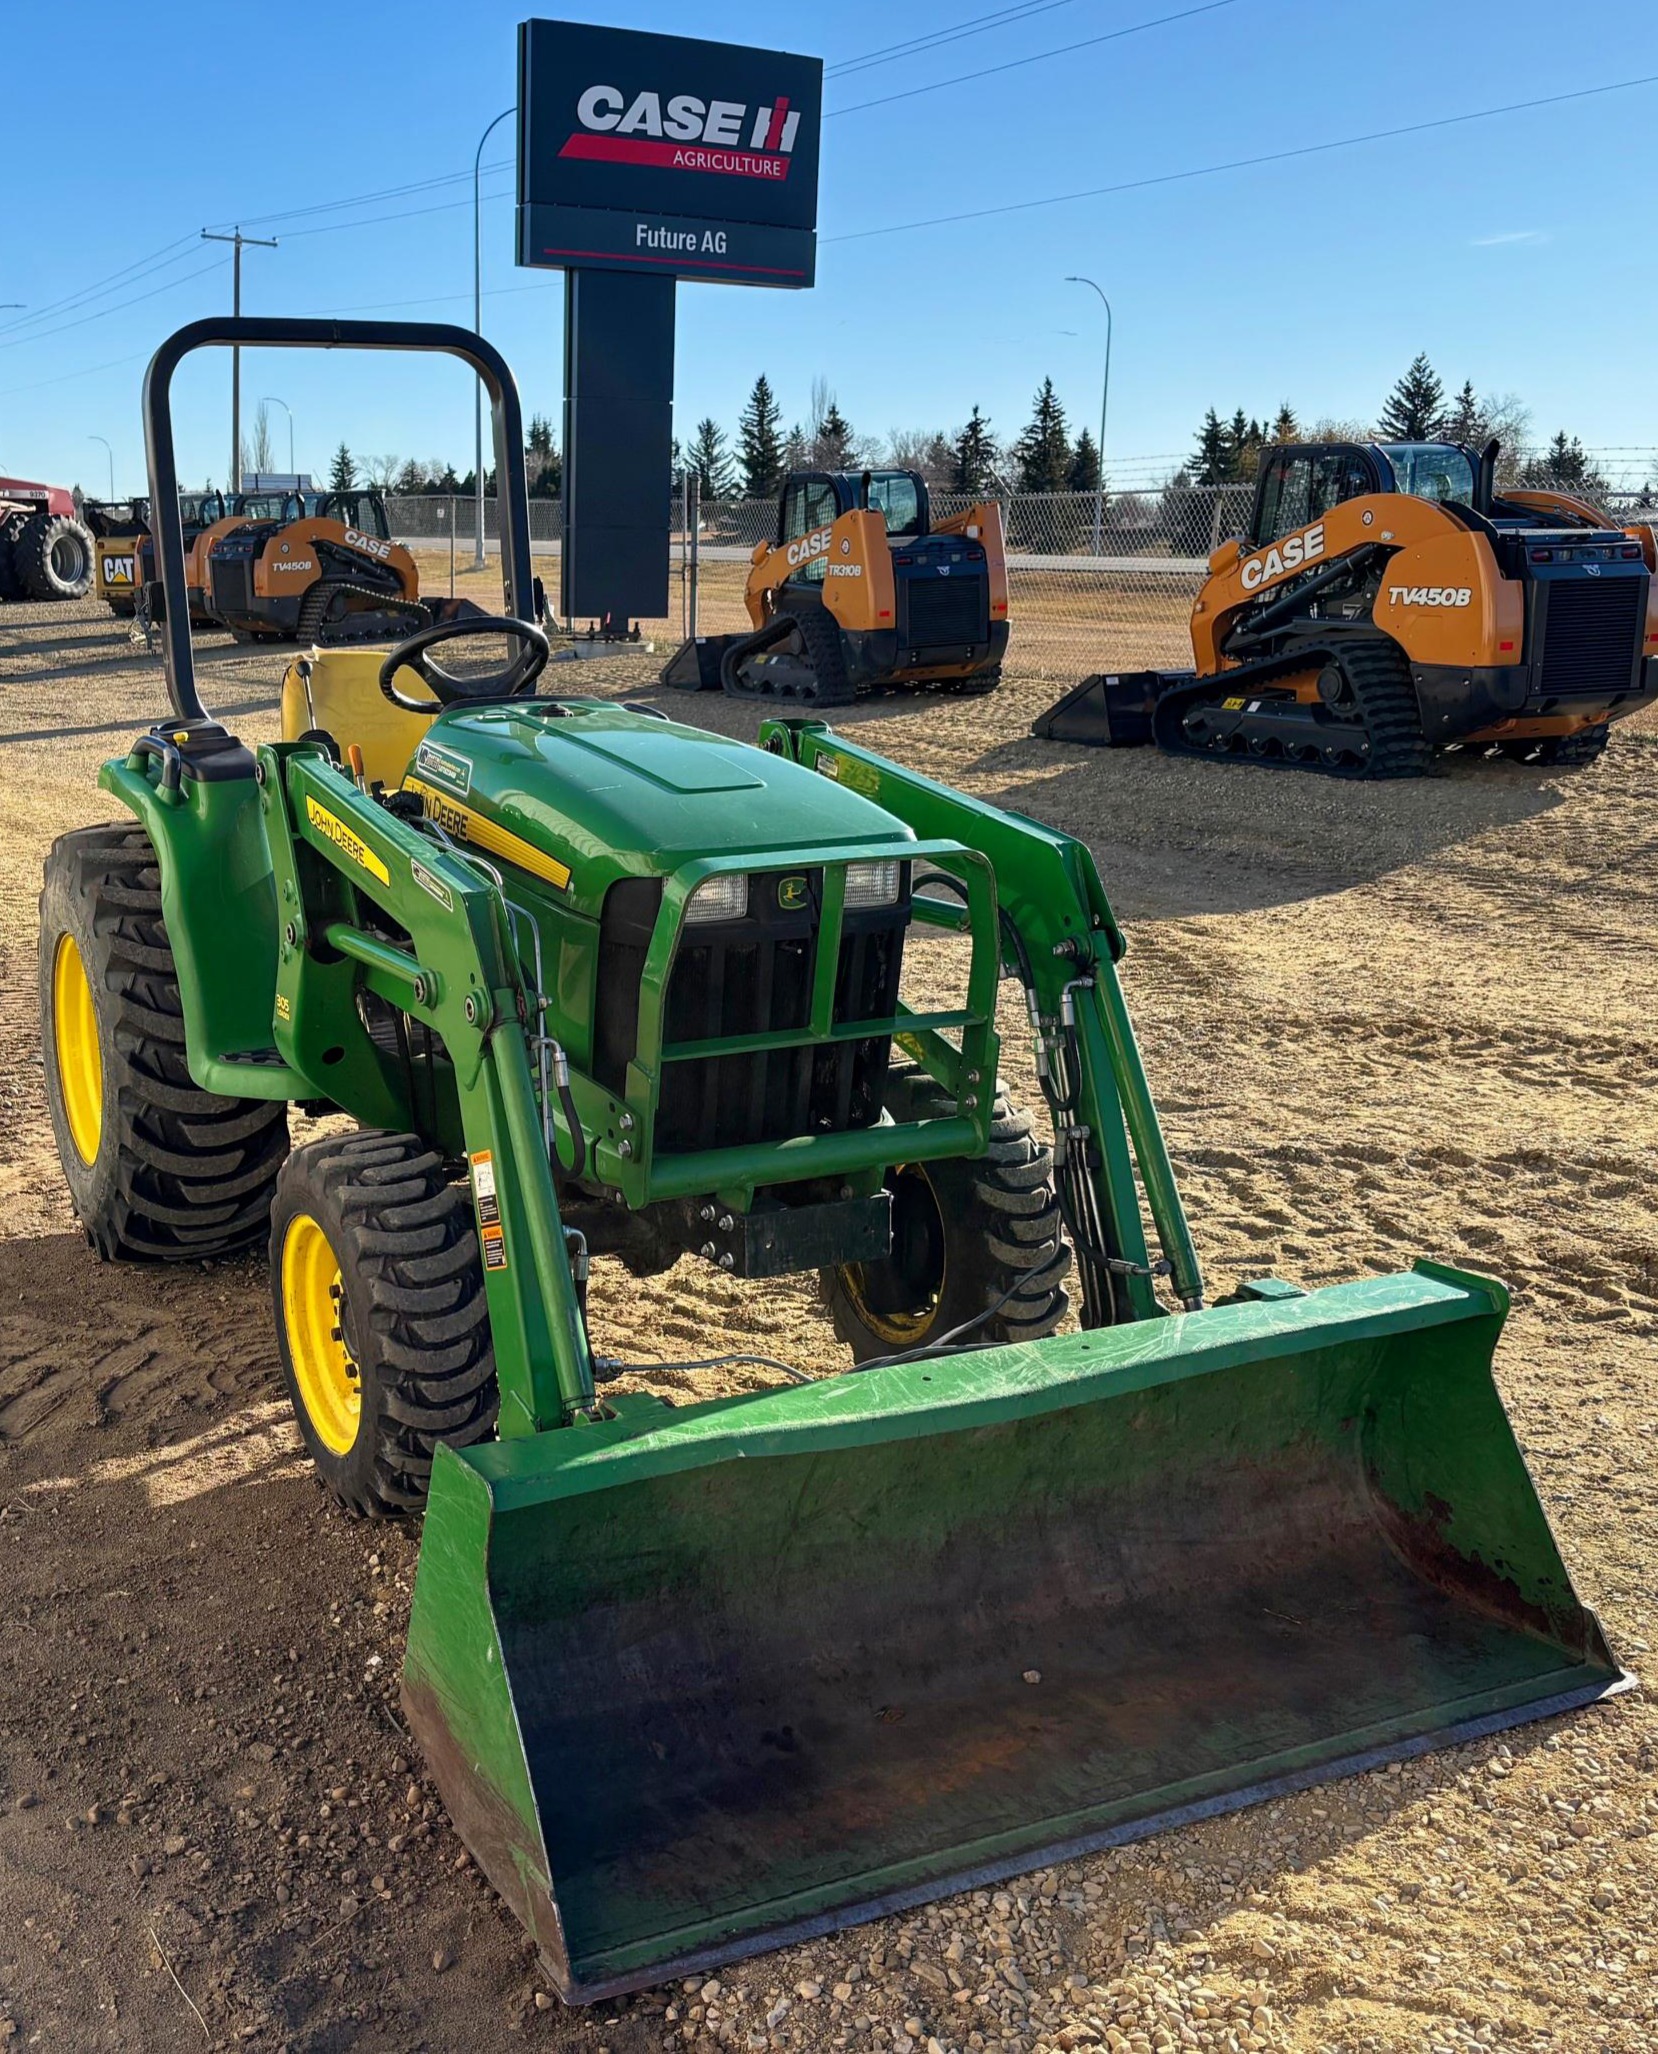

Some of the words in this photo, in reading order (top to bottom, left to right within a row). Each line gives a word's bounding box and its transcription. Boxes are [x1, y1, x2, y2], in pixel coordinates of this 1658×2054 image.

[577, 85, 747, 146] CASE
[673, 150, 781, 176] AGRICULTURE
[636, 224, 697, 251] Future
[700, 231, 727, 254] AG
[344, 530, 391, 559] CASE
[787, 526, 833, 566] CASE
[1240, 524, 1326, 590] CASE
[103, 557, 134, 583] CAT
[272, 561, 312, 572] TV450B
[828, 564, 862, 577] TR310B
[1388, 586, 1472, 607] TV450B
[432, 795, 469, 839] DEERE
[310, 804, 334, 838] JOHN
[335, 822, 365, 865] DEERE
[276, 994, 290, 1012] 305
